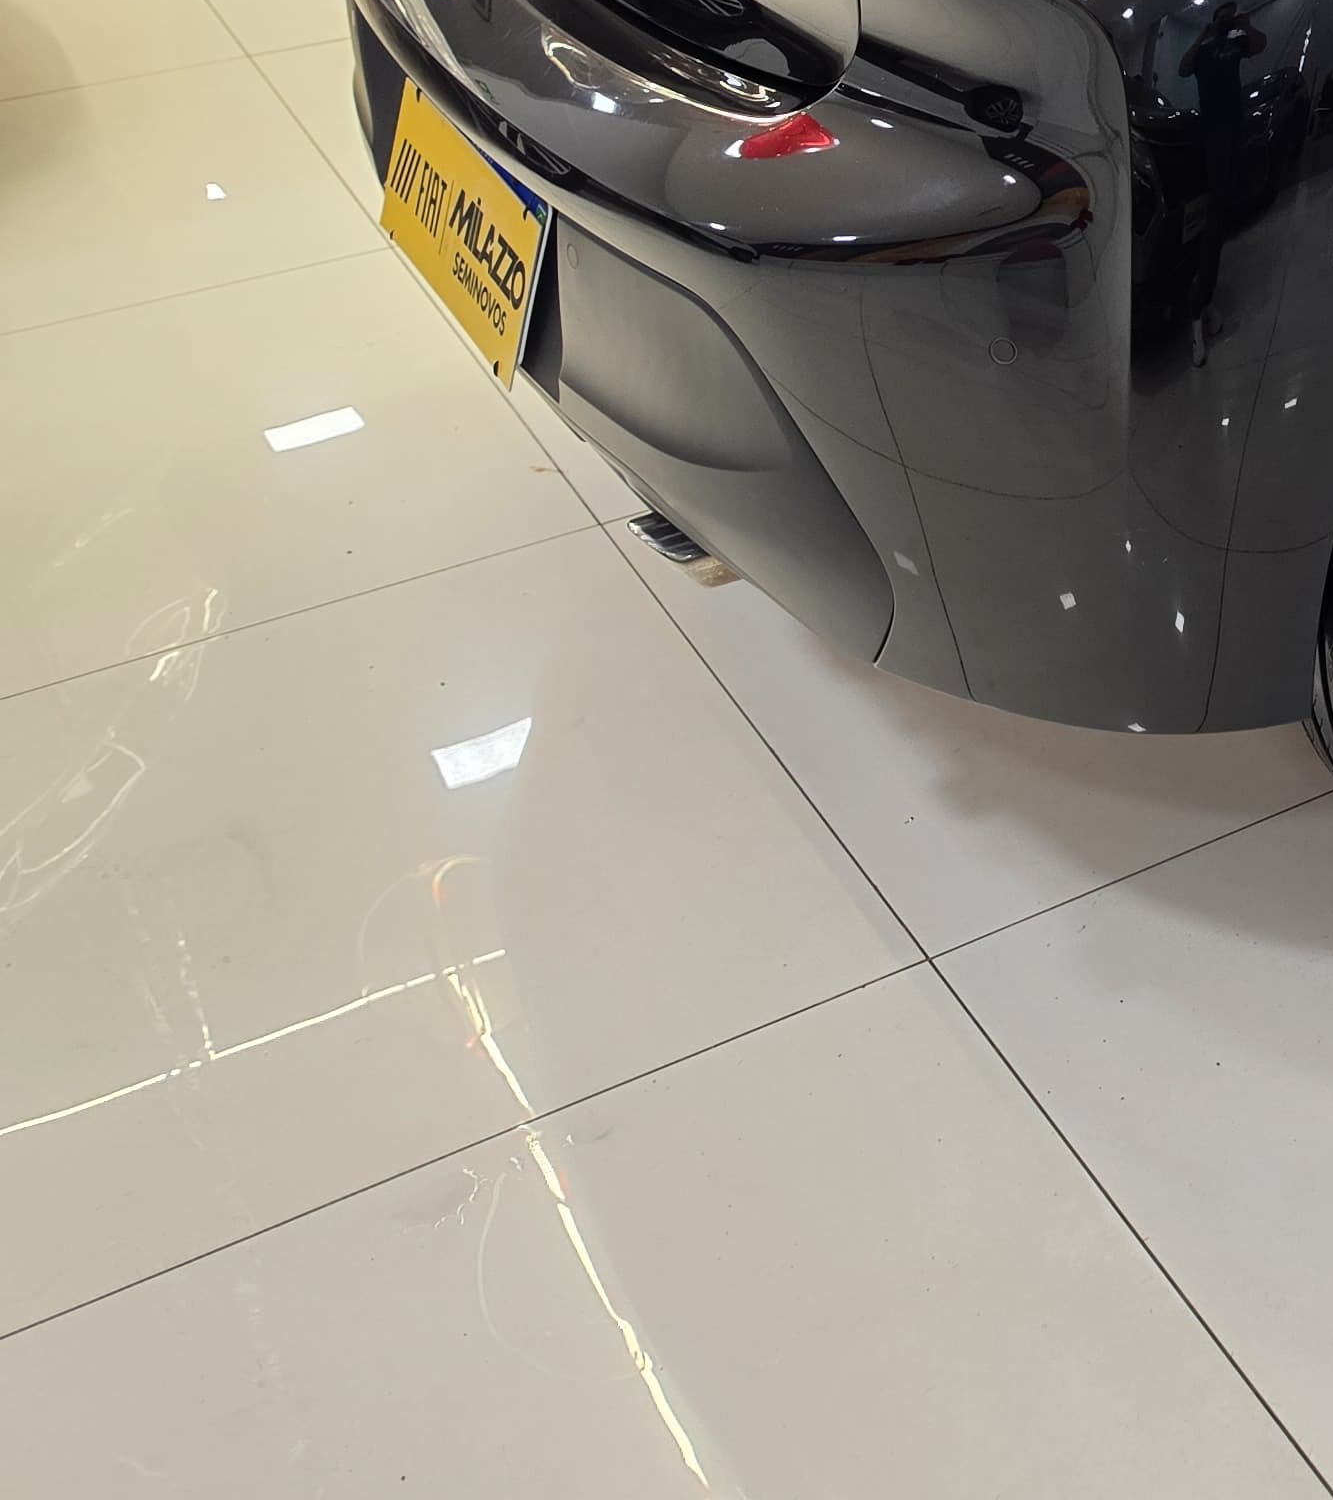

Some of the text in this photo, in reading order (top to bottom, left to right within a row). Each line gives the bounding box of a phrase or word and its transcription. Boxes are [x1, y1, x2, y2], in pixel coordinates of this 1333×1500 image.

[415, 160, 526, 311] FIAT MILAZZO
[452, 252, 507, 336] SEMINOVOS
